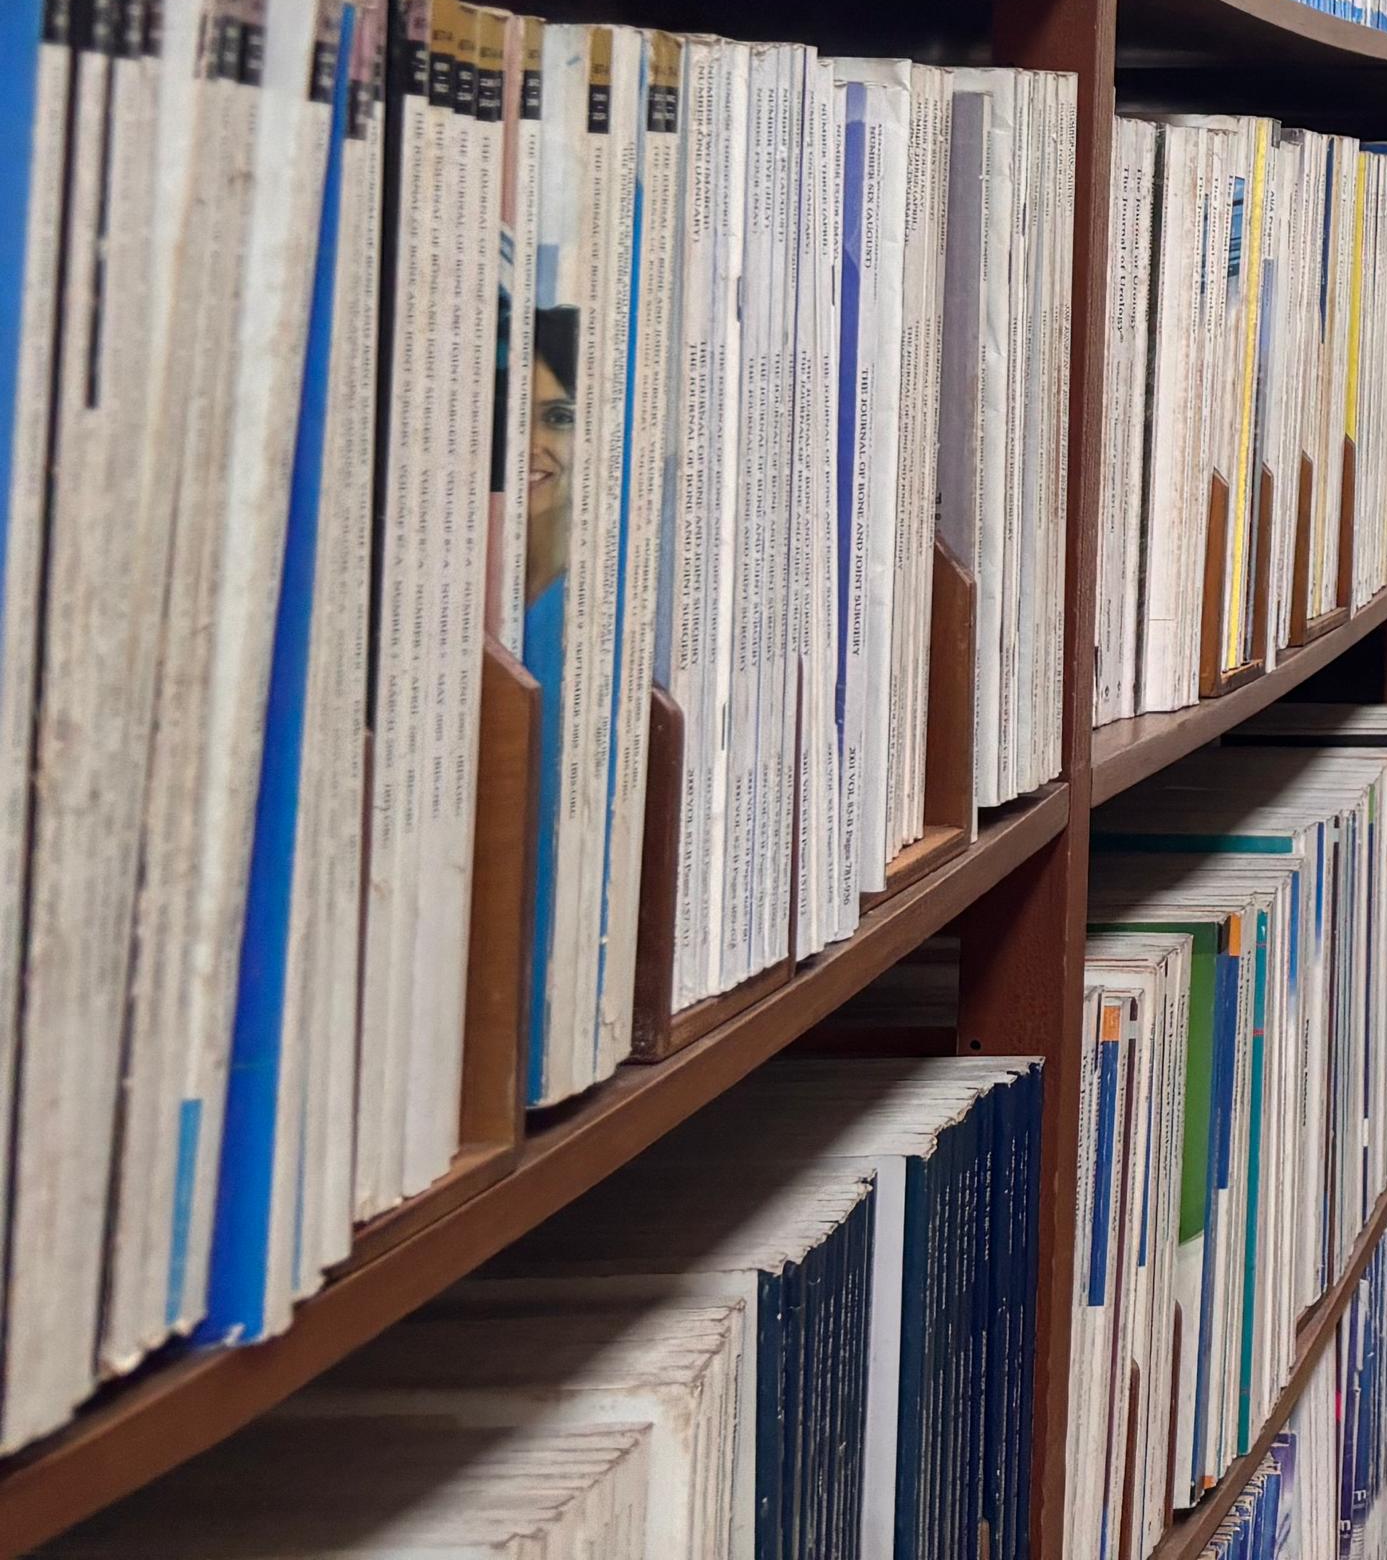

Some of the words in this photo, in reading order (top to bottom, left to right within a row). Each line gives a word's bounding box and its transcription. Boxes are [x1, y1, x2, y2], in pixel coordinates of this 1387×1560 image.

[867, 126, 876, 180] NUMBER
[867, 183, 876, 205] SIX
[1135, 169, 1143, 192] The
[865, 208, 875, 269] (AUGUST)
[1120, 196, 1129, 251] Journal
[1133, 198, 1142, 250] Journal
[1119, 256, 1127, 272] of
[1133, 256, 1140, 271] of
[689, 344, 698, 373] THE
[861, 368, 869, 394] THE
[687, 377, 696, 441] JOURNAL
[860, 398, 868, 459] JOURNAL
[687, 450, 694, 469] OF
[859, 462, 866, 479] OF
[685, 475, 694, 514] BONE
[685, 520, 693, 552] AND
[683, 558, 692, 598] JOINT
[680, 603, 691, 671] SURGERY
[852, 595, 862, 655] SURGERY
[847, 773, 856, 798] VOL
[844, 830, 854, 860] Pages
